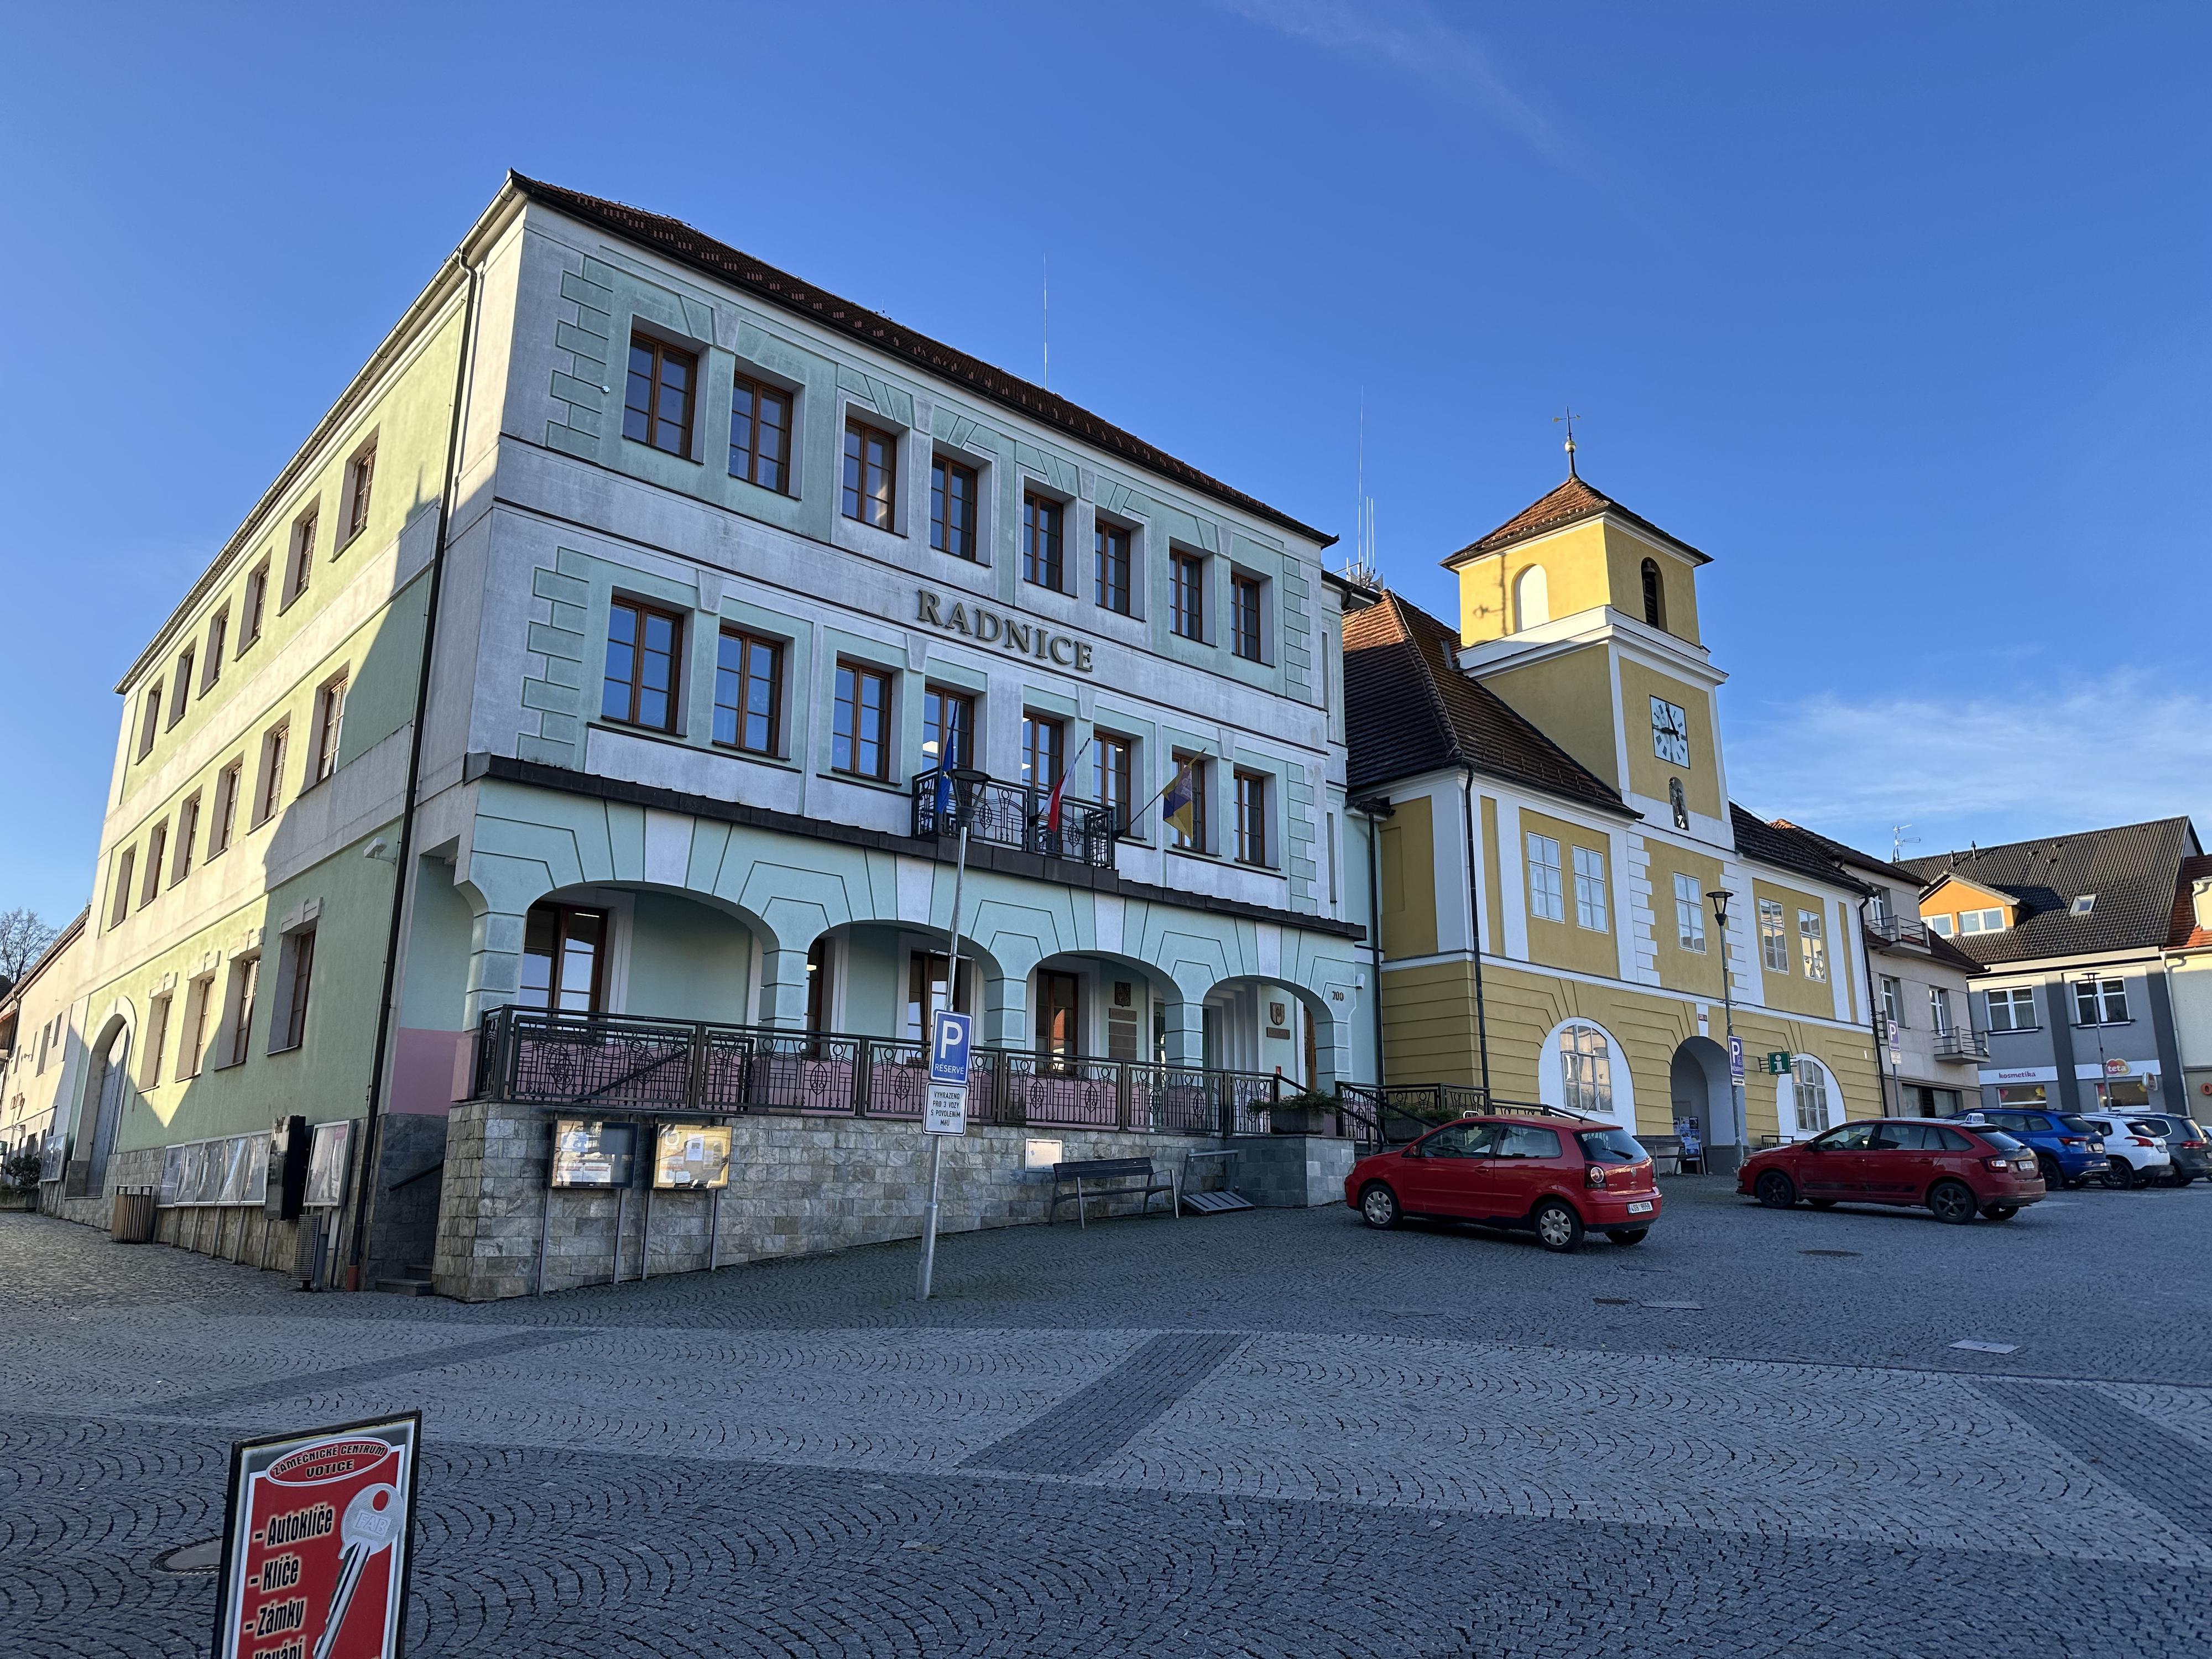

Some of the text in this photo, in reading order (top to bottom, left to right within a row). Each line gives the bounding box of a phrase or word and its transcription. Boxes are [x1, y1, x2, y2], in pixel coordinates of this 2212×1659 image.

[917, 589, 1093, 673] RADNICE
[940, 1020, 963, 1059] P
[1889, 1024, 1896, 1041] P
[1731, 1041, 1740, 1063] P
[935, 1062, 964, 1074] RÉSERVÉ
[934, 1091, 960, 1100] VYHRAZENO
[936, 1109, 961, 1118] POVOLENÍM
[273, 1444, 386, 1475] ZÁMEČNICKÉ CENTRUM
[306, 1460, 353, 1478] VOTICE
[267, 1505, 333, 1546] Autoklíče
[356, 1512, 388, 1534] FAB
[263, 1555, 299, 1591] Klíče
[257, 1600, 304, 1636] Zámky
